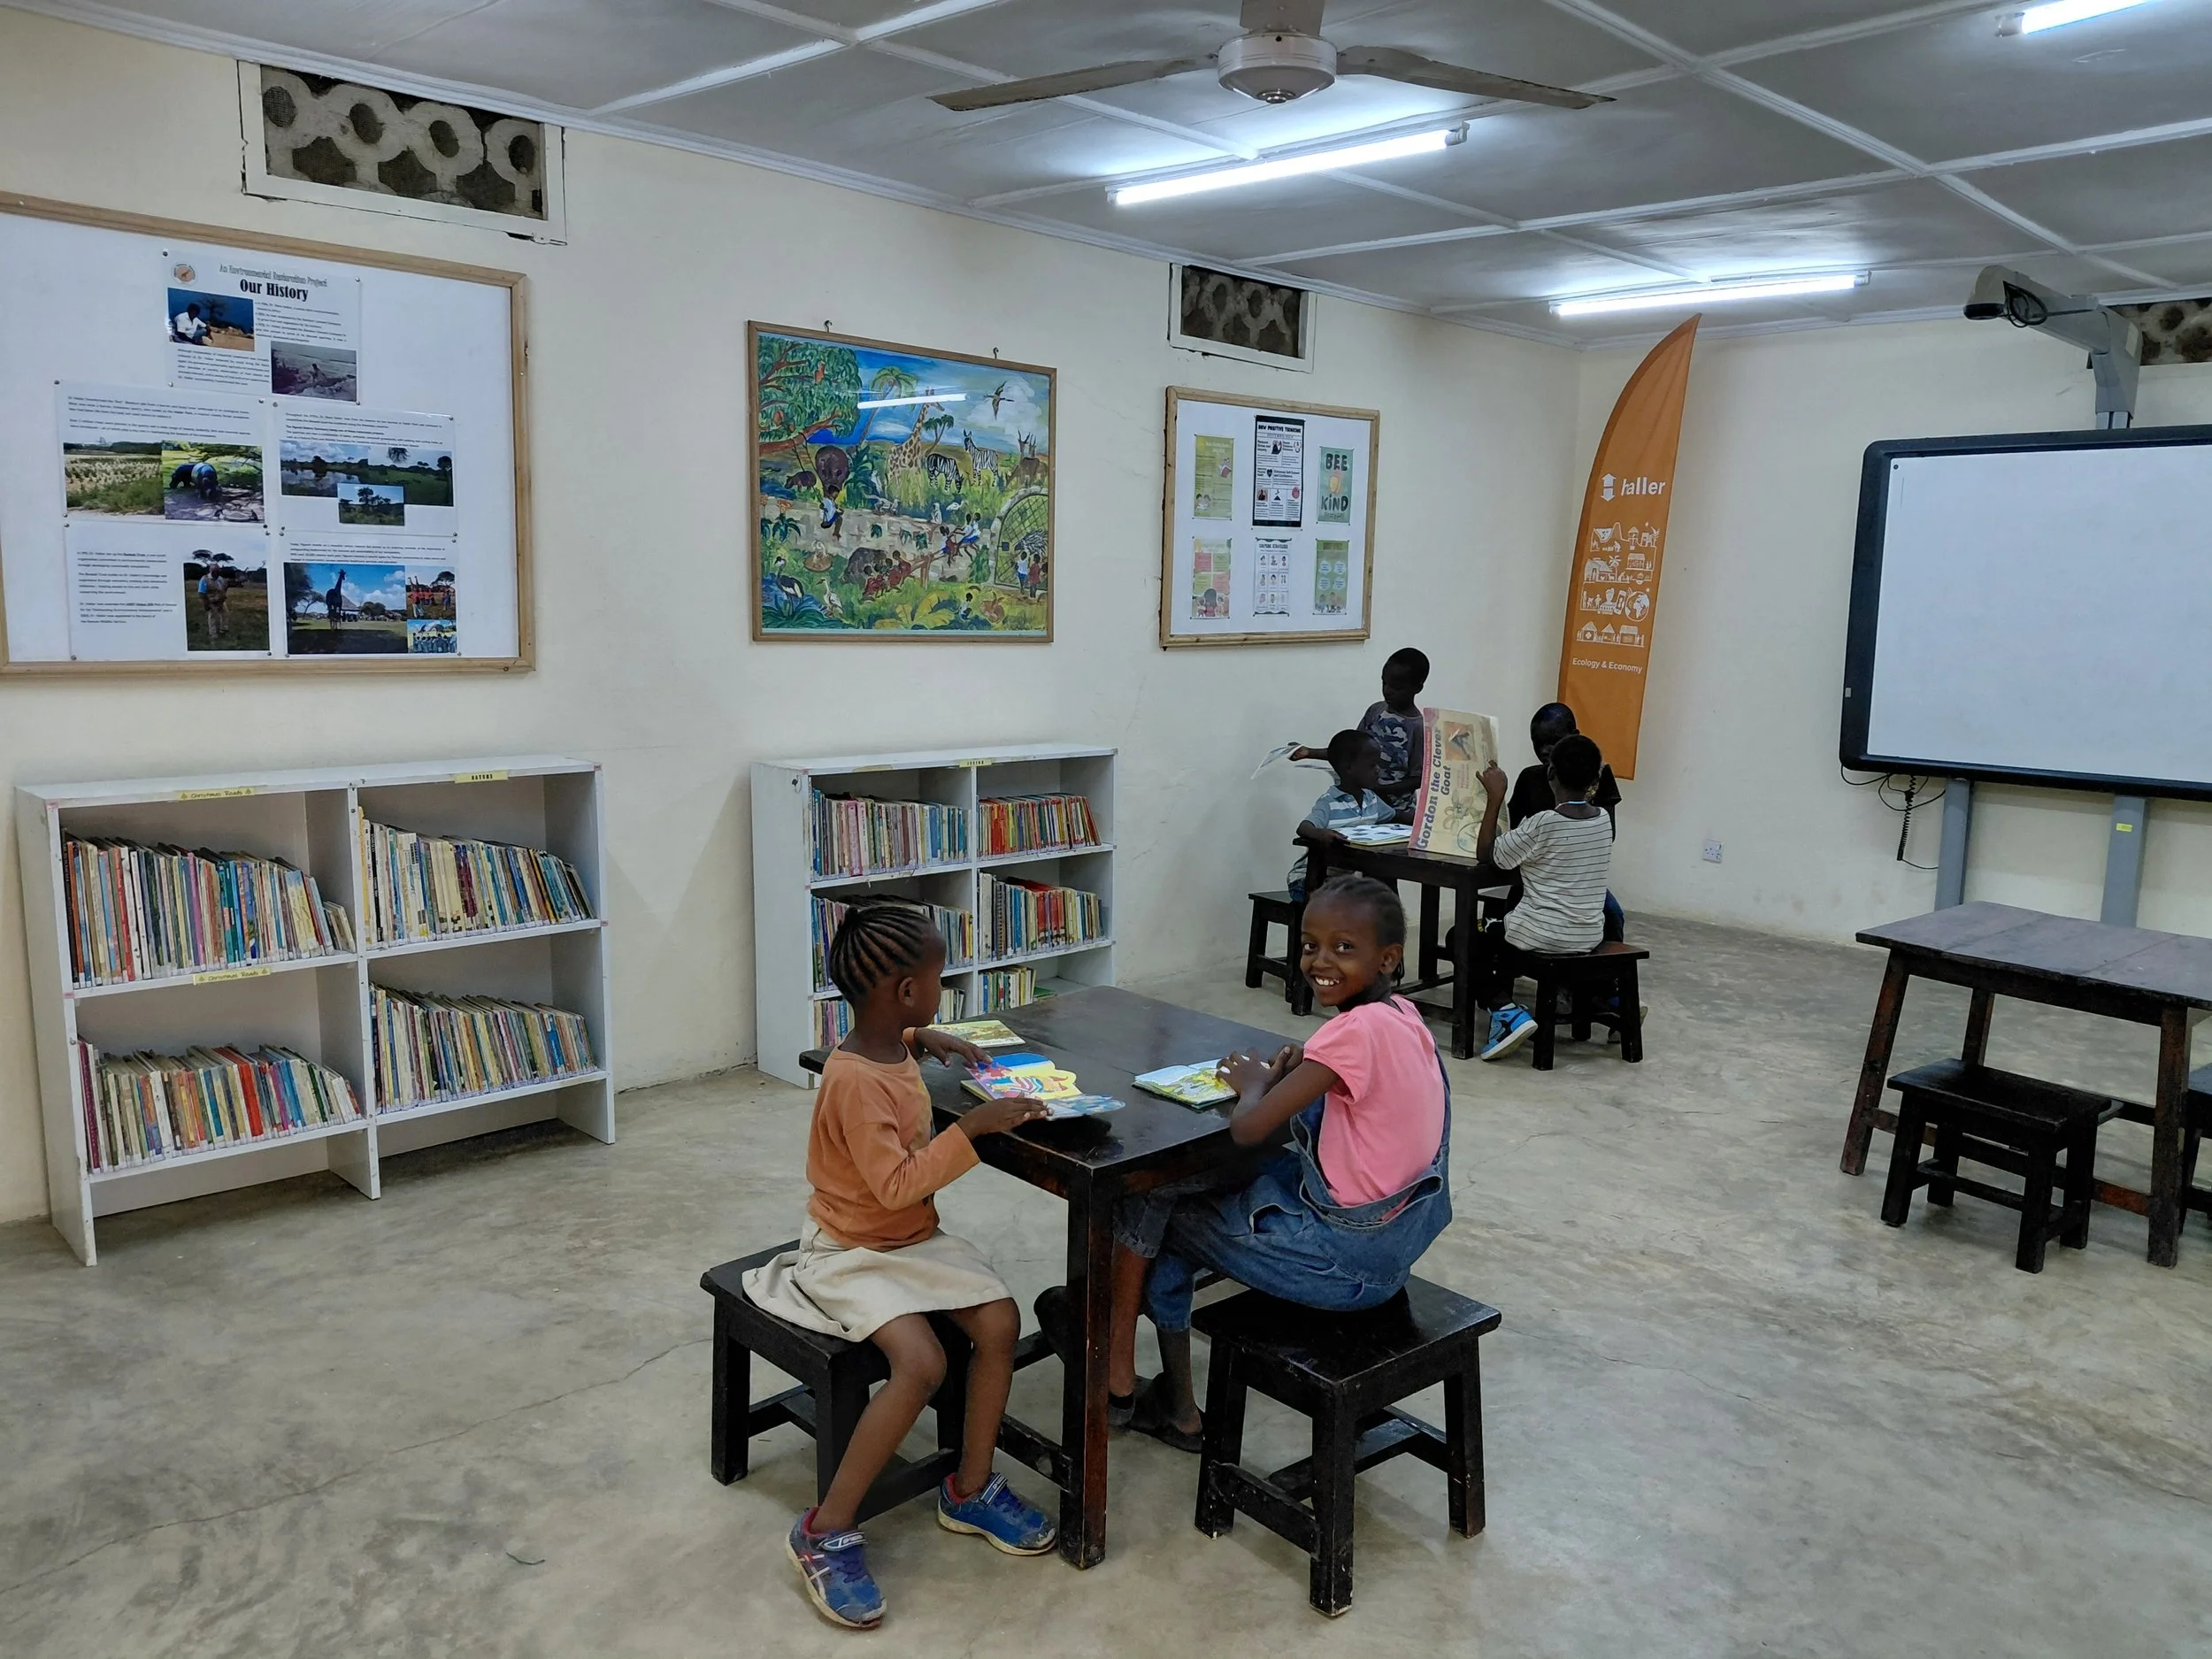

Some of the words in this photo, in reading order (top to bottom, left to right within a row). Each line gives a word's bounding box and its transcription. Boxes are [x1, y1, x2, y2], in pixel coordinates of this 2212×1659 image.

[240, 279, 262, 295] Our
[266, 281, 309, 302] History
[1325, 453, 1348, 471] BEE
[1621, 476, 1666, 496] haller
[1572, 657, 1601, 669] Ecology
[1601, 661, 1608, 669] &
[1609, 660, 1643, 674] Economy
[1432, 728, 1442, 768] Clever
[1430, 772, 1440, 791] the
[1440, 765, 1452, 796] Goat
[1416, 795, 1438, 849] Gordon
